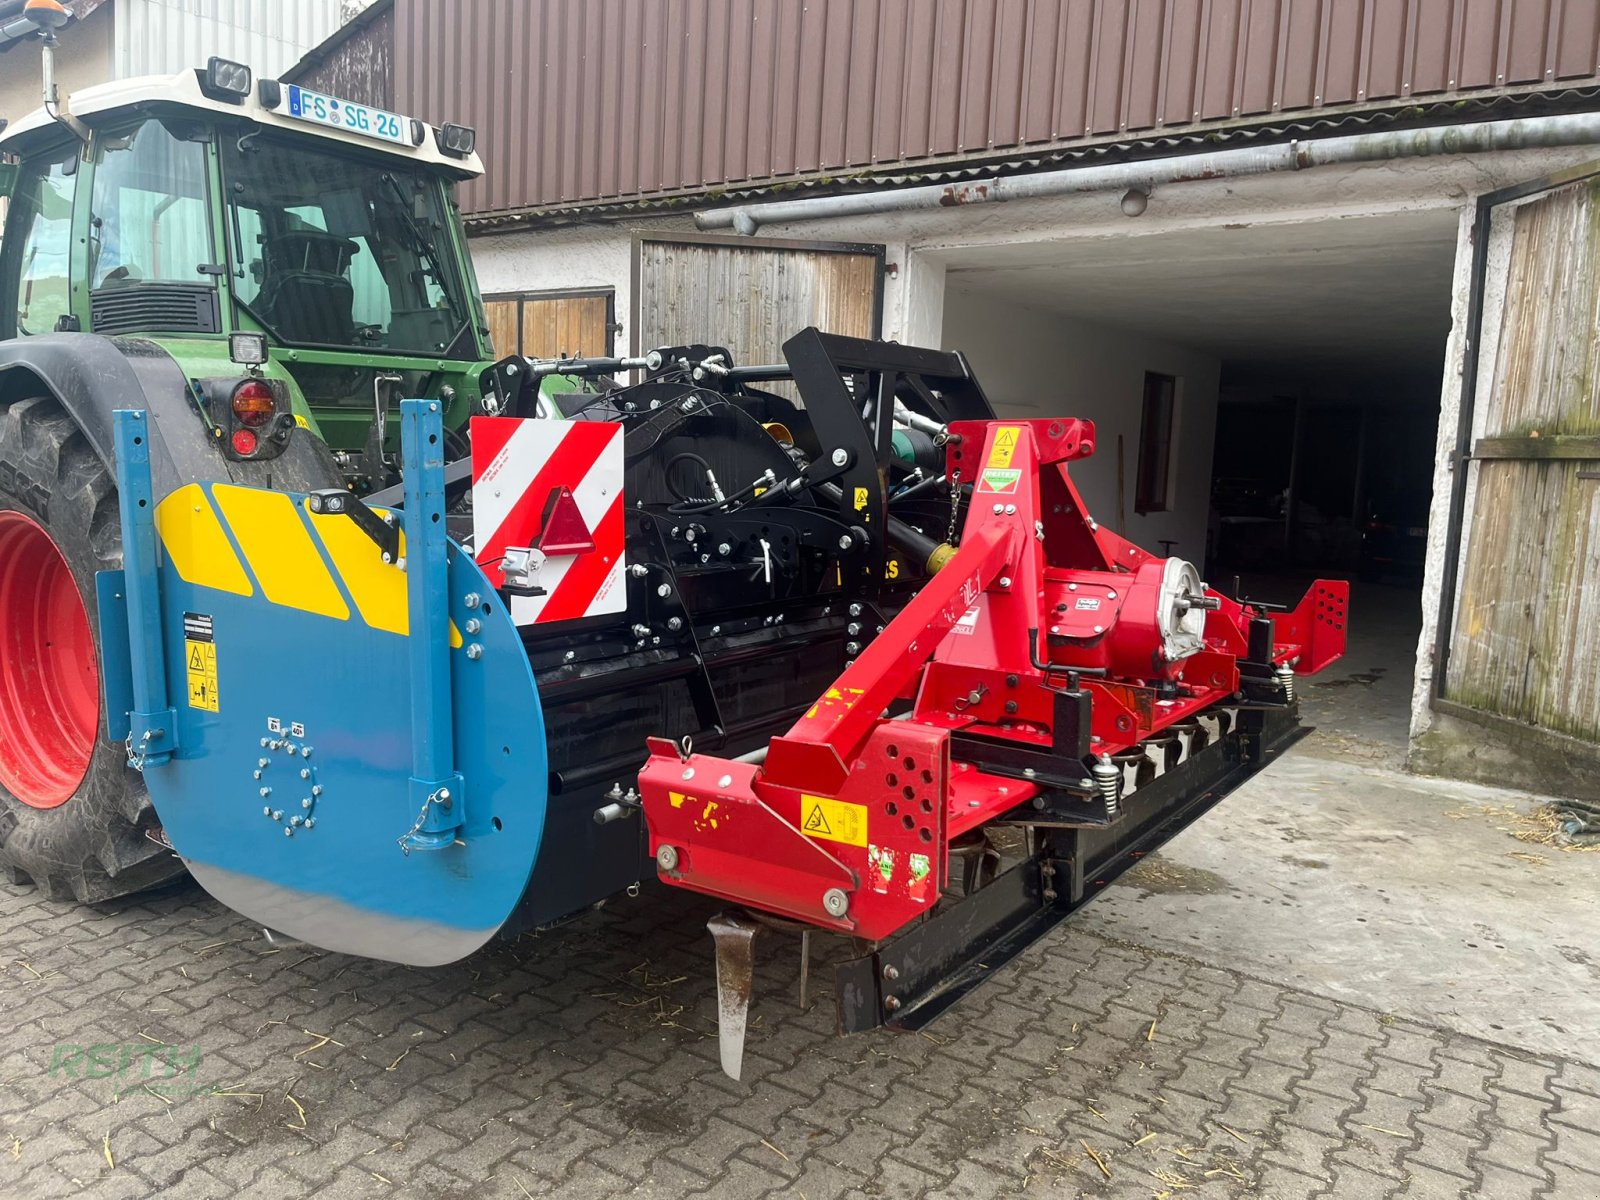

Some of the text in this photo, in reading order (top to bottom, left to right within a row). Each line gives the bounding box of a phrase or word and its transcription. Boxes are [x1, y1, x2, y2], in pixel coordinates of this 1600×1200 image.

[293, 92, 399, 138] D FS SG 26
